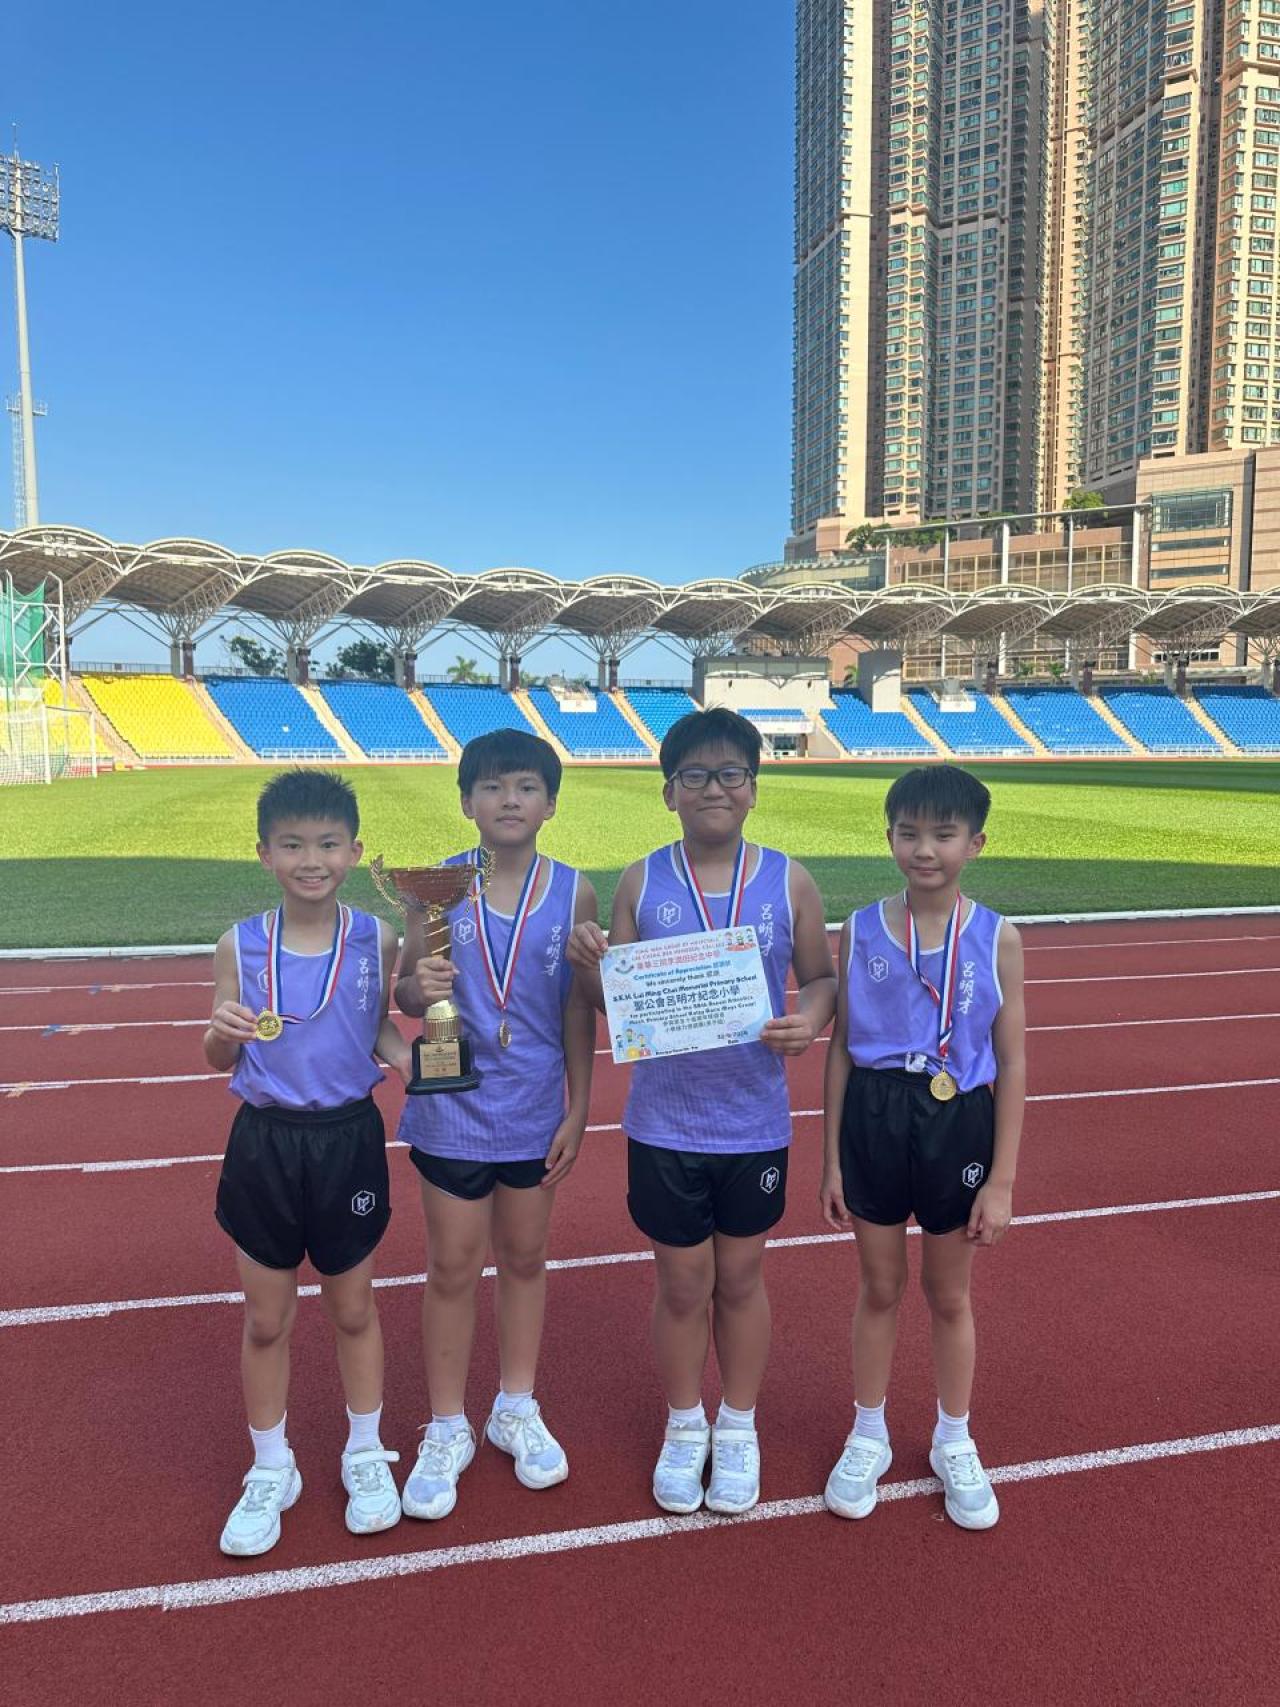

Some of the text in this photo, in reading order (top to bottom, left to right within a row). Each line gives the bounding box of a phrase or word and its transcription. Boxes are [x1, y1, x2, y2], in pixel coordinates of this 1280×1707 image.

[543, 925, 563, 977] 呂明才
[758, 903, 774, 956] 呂明才
[357, 957, 370, 1012] 呂明才
[632, 985, 740, 1011] 聖公會呂明才紀念小學
[678, 983, 708, 991] Memorial
[709, 978, 735, 987] Primary
[735, 974, 756, 982] School
[957, 960, 976, 1014] 呂明才
